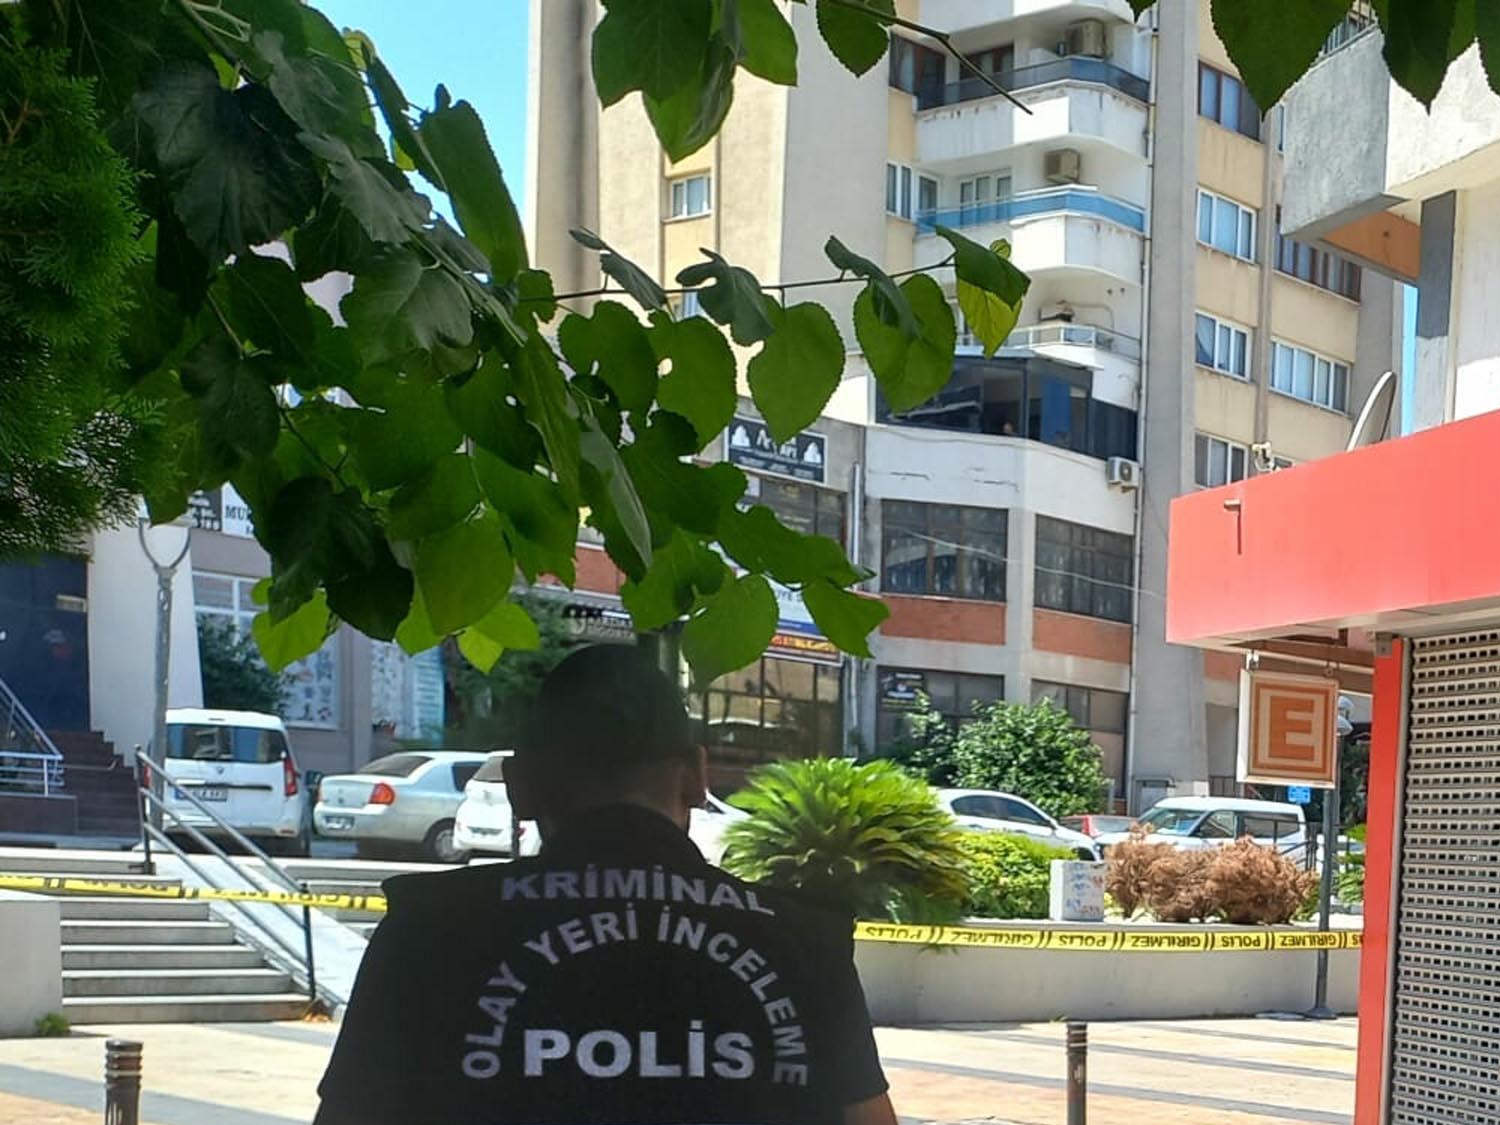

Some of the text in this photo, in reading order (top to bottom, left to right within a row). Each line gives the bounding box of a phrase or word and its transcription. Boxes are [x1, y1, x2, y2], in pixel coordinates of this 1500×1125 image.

[1268, 695, 1315, 762] E
[502, 863, 776, 917] KRİMİNAL
[461, 902, 809, 1087] OLAY YERİ İNCELEME
[522, 1020, 755, 1078] POLİS
